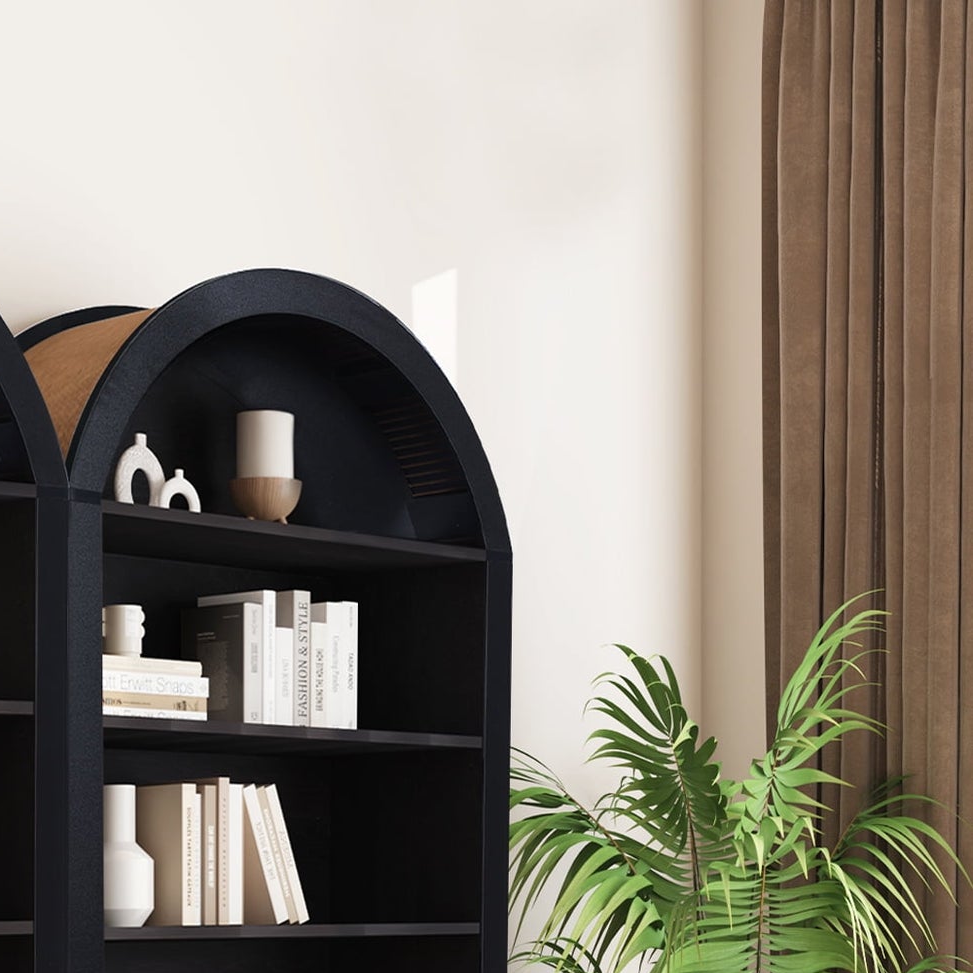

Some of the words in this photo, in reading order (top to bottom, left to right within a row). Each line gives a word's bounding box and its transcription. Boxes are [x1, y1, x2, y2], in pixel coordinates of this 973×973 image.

[298, 602, 308, 643] STYLE
[298, 647, 308, 657] &
[120, 675, 153, 692] Erwitt
[155, 677, 195, 696] Snaps
[298, 659, 308, 717] FASHION
